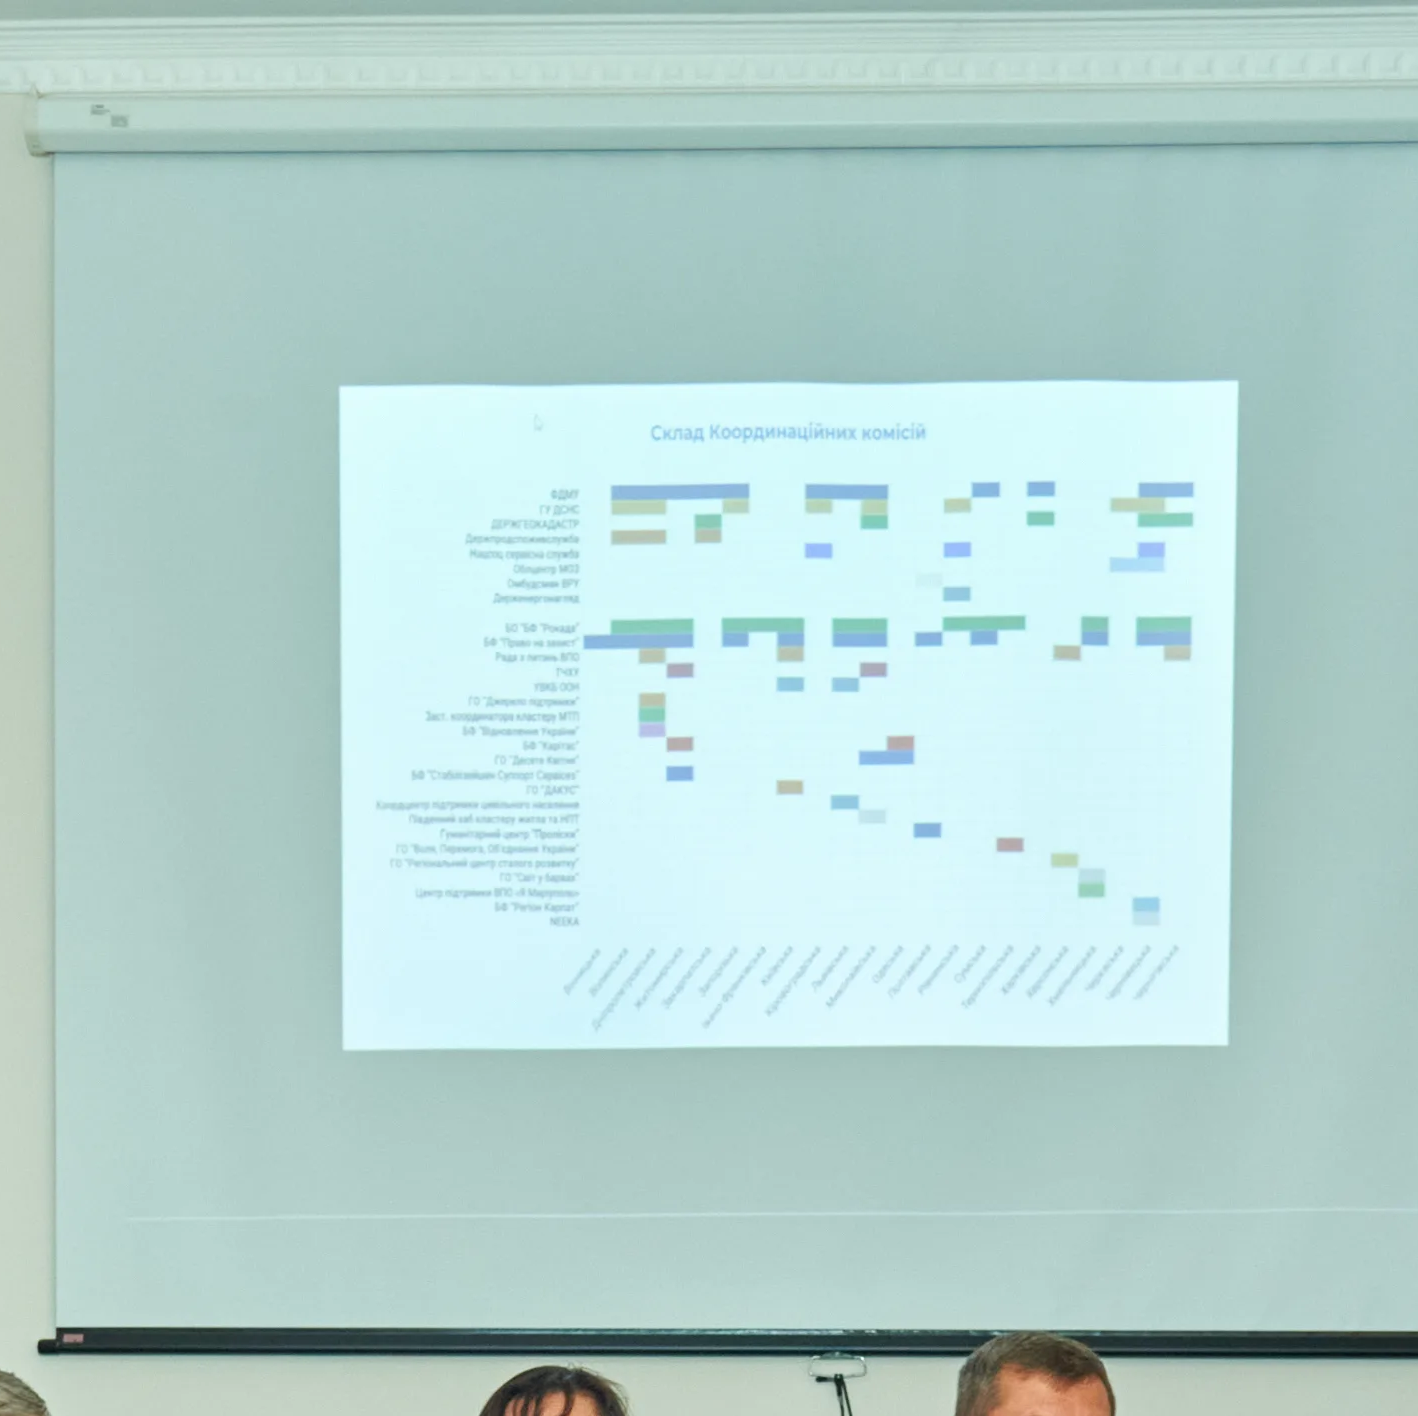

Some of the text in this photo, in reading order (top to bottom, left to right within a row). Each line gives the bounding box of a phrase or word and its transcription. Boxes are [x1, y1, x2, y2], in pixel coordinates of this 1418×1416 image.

[650, 422, 926, 444] Склад Координаційних комісій
